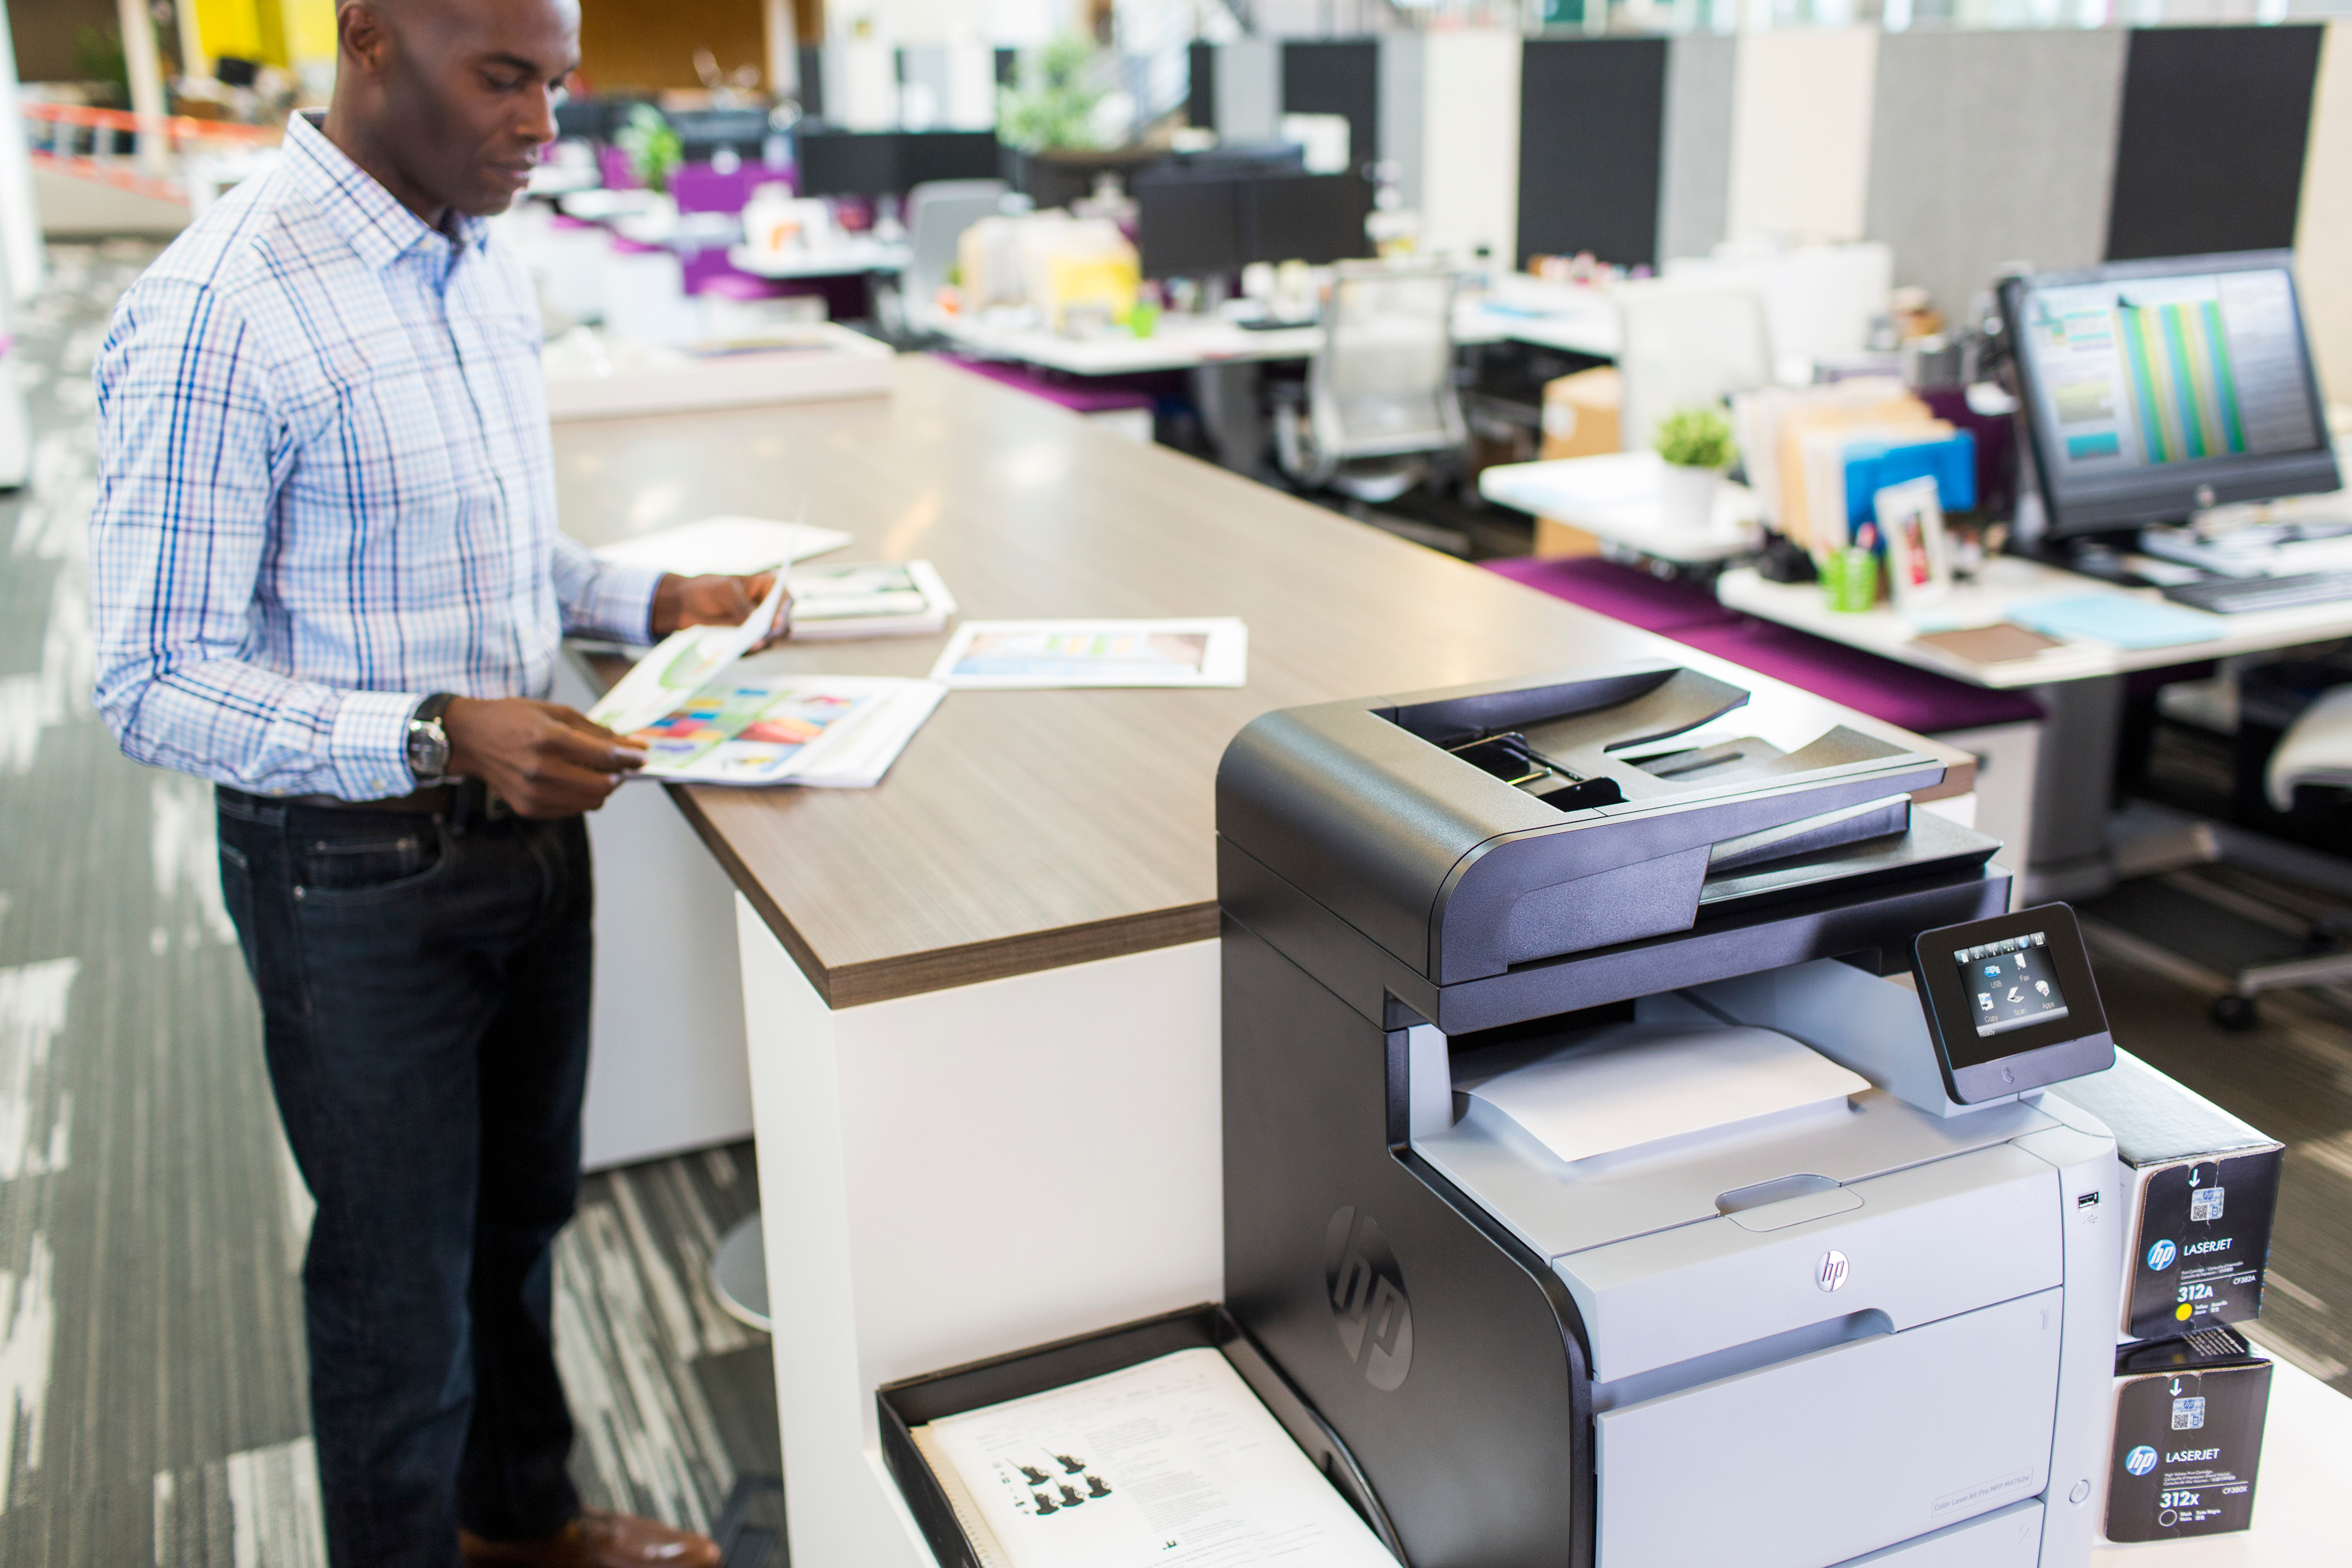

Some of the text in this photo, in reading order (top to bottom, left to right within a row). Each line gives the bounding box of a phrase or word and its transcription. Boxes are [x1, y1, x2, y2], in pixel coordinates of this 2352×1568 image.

[2204, 1190, 2213, 1200] hp
[2149, 1239, 2176, 1271] hp
[2183, 1238, 2233, 1256] LASERJET
[1820, 1251, 1845, 1291] hp
[2233, 1275, 2256, 1285] CF382A
[2176, 1283, 2213, 1302] 312A
[2185, 1399, 2194, 1409] hp
[2127, 1445, 2156, 1476] hp
[2166, 1448, 2220, 1463] LASERJET
[1935, 1501, 1950, 1511] Color
[1952, 1492, 1977, 1505] LaserJet
[1991, 1483, 2003, 1492] MFP
[2005, 1475, 2030, 1488] M476dw
